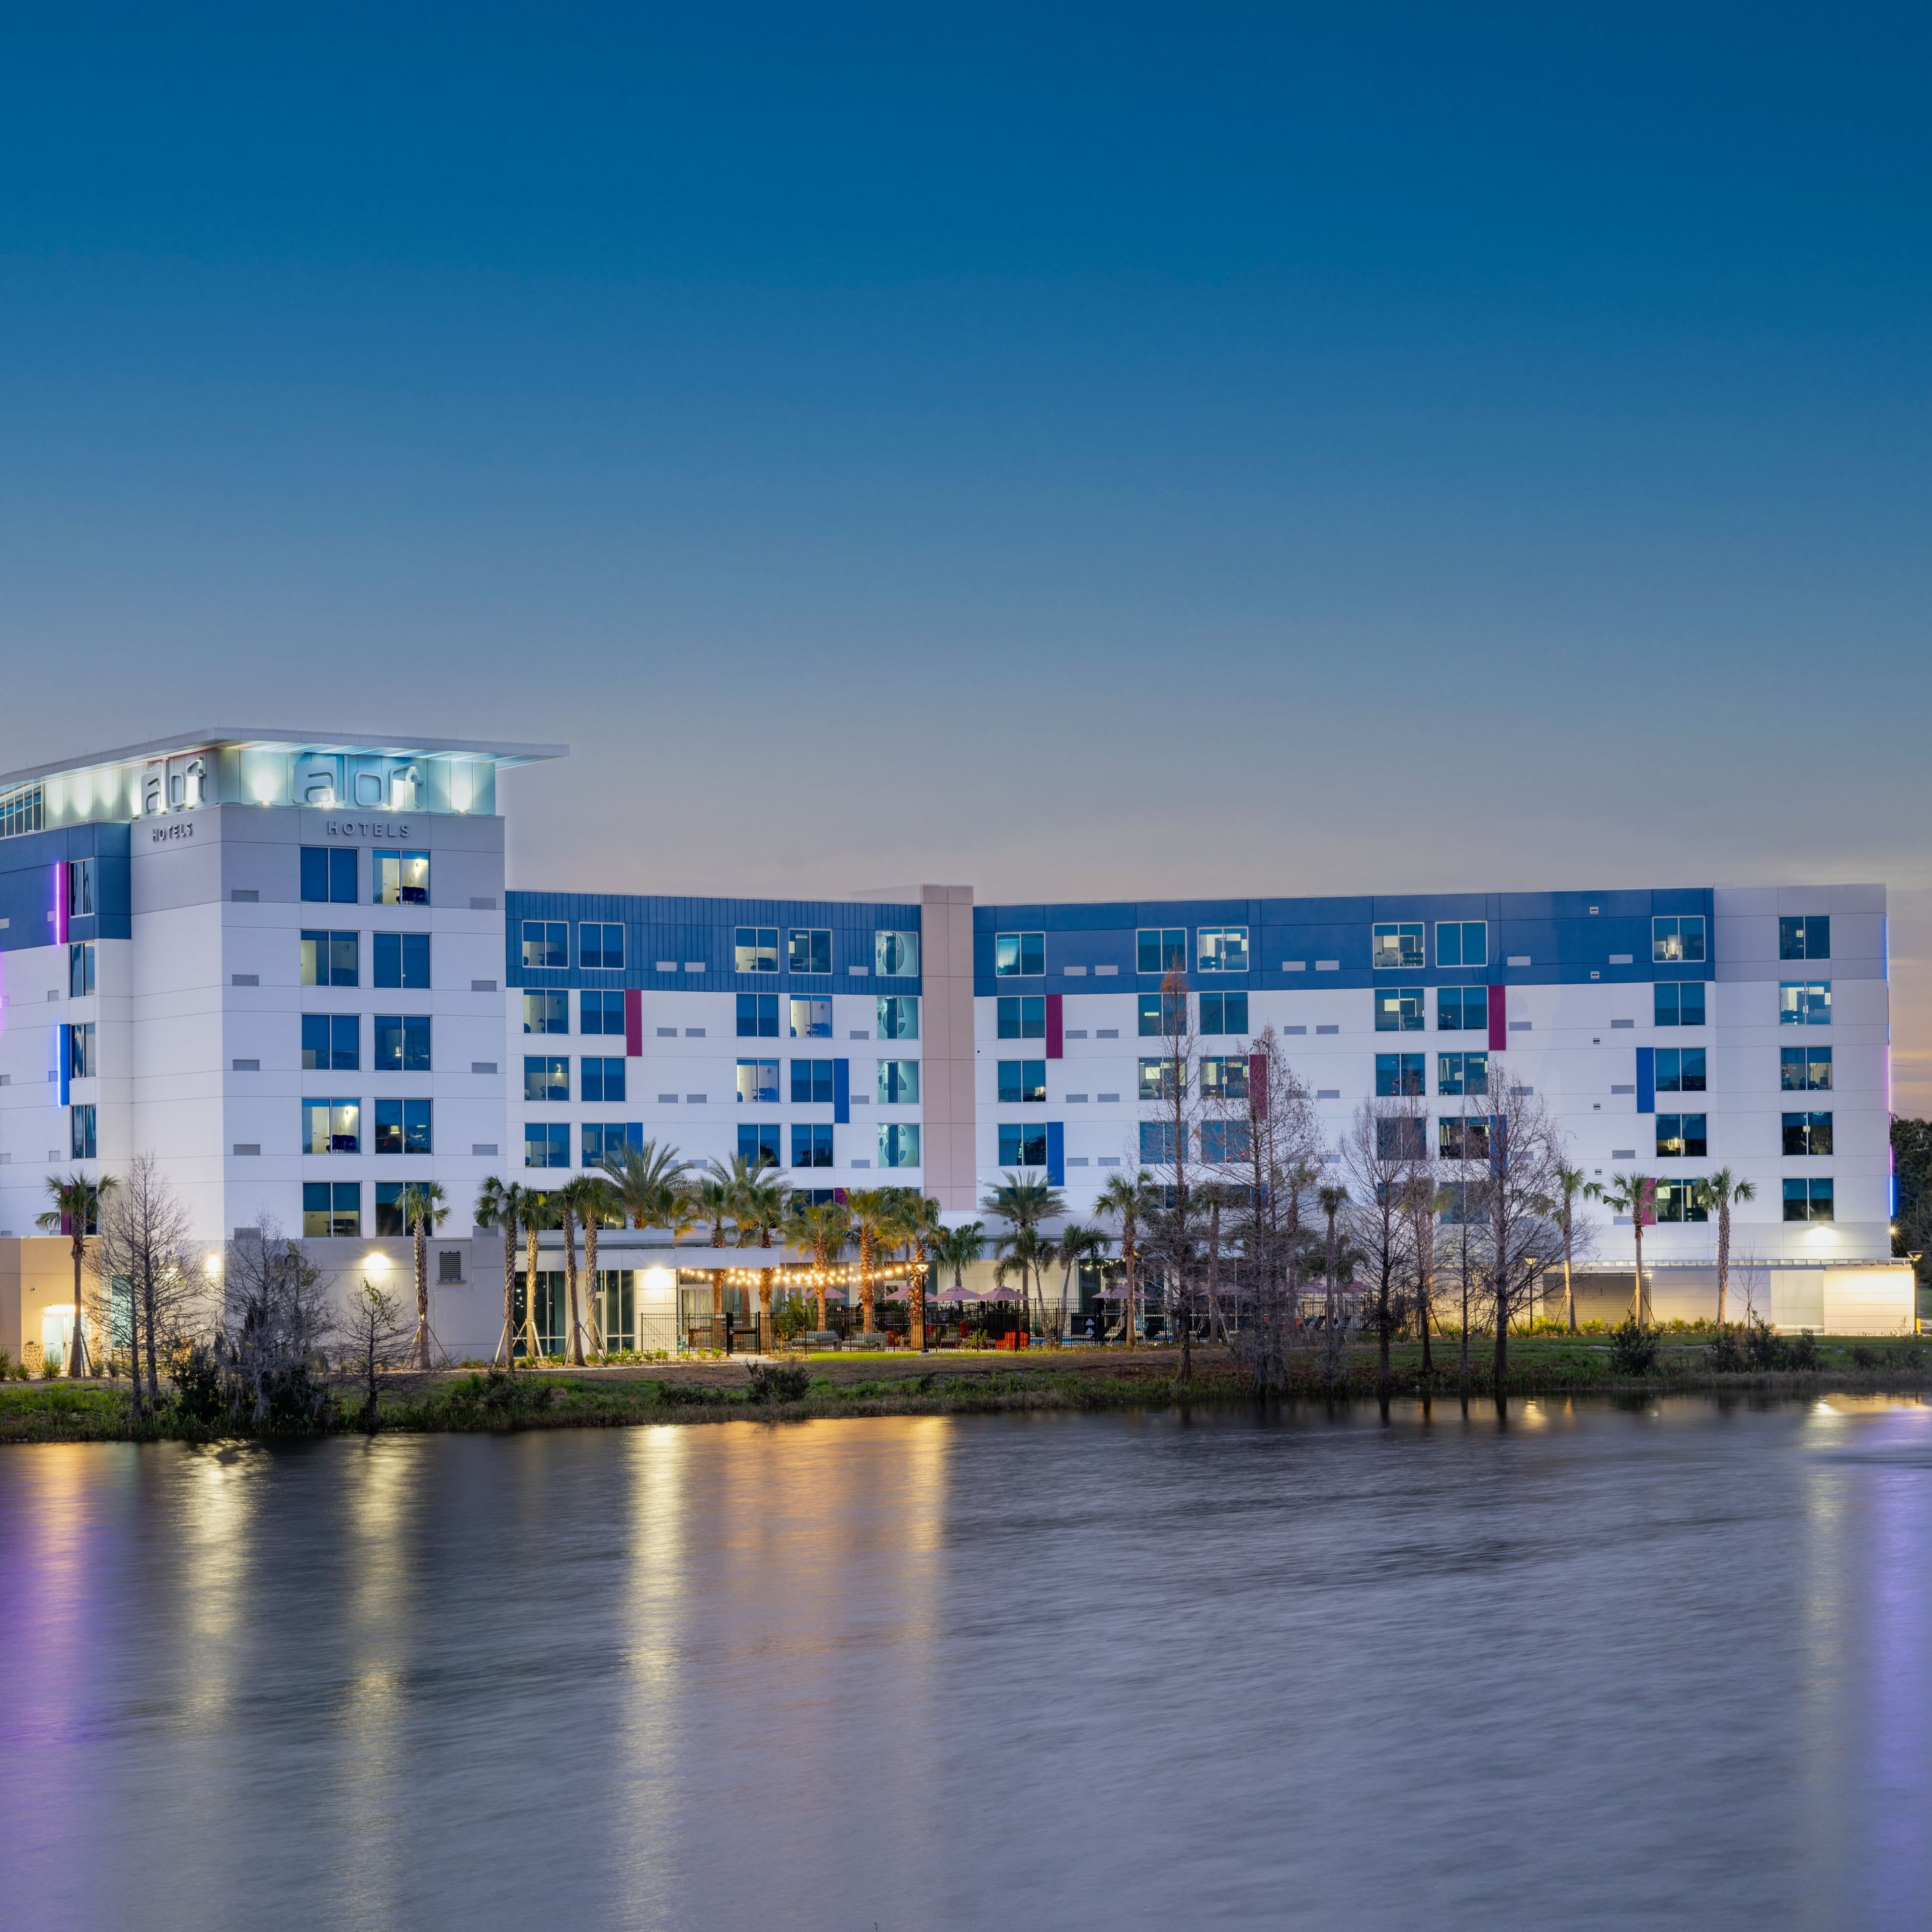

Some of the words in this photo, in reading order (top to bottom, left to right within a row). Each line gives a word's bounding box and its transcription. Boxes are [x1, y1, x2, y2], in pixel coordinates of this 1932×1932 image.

[141, 757, 206, 813] aloft
[292, 754, 424, 808] aloft
[152, 822, 193, 843] HOTELS
[327, 821, 411, 837] HOTELS
